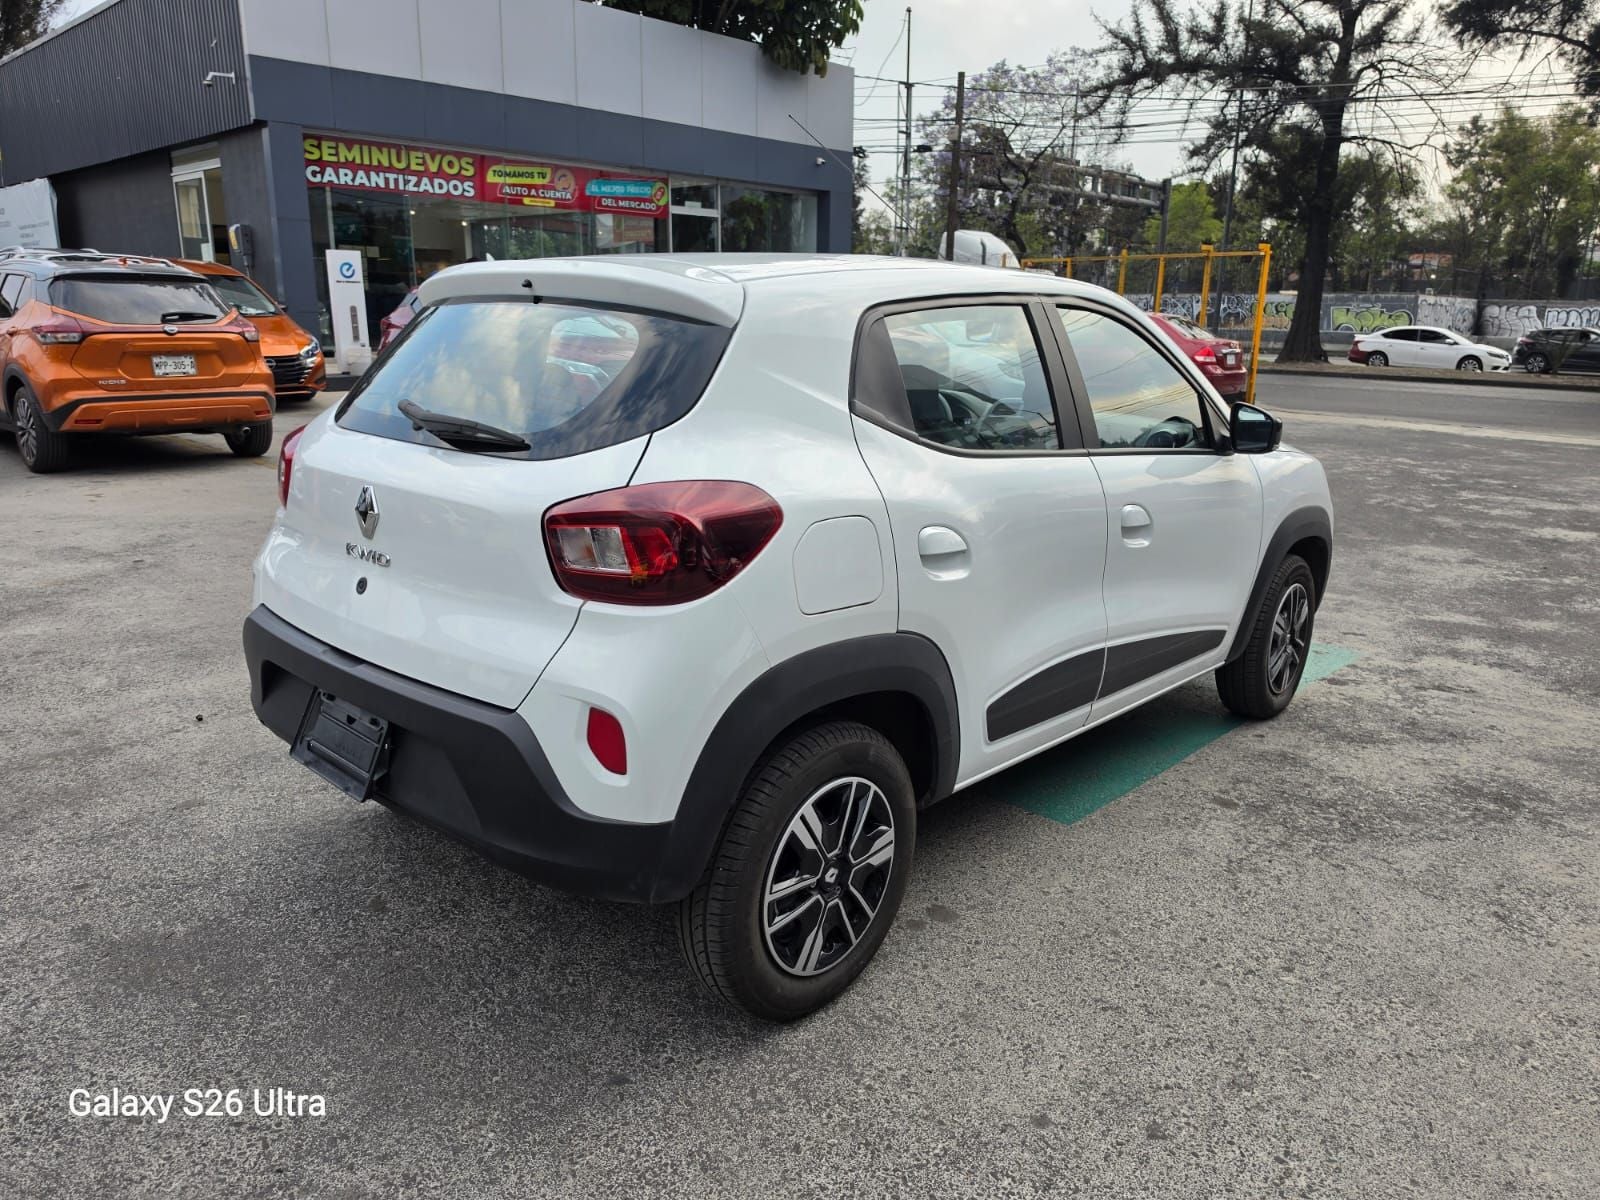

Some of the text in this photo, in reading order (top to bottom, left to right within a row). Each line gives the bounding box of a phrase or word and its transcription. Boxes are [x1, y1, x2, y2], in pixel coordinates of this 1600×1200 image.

[303, 138, 476, 177] SEMINUEVOS
[305, 165, 476, 197] GARANTIZADOS
[492, 169, 548, 179] TOMAMOS TU
[502, 185, 573, 200] AUTO A CUENTA
[601, 198, 657, 210] DEL MERCADO
[345, 542, 392, 568] KWID
